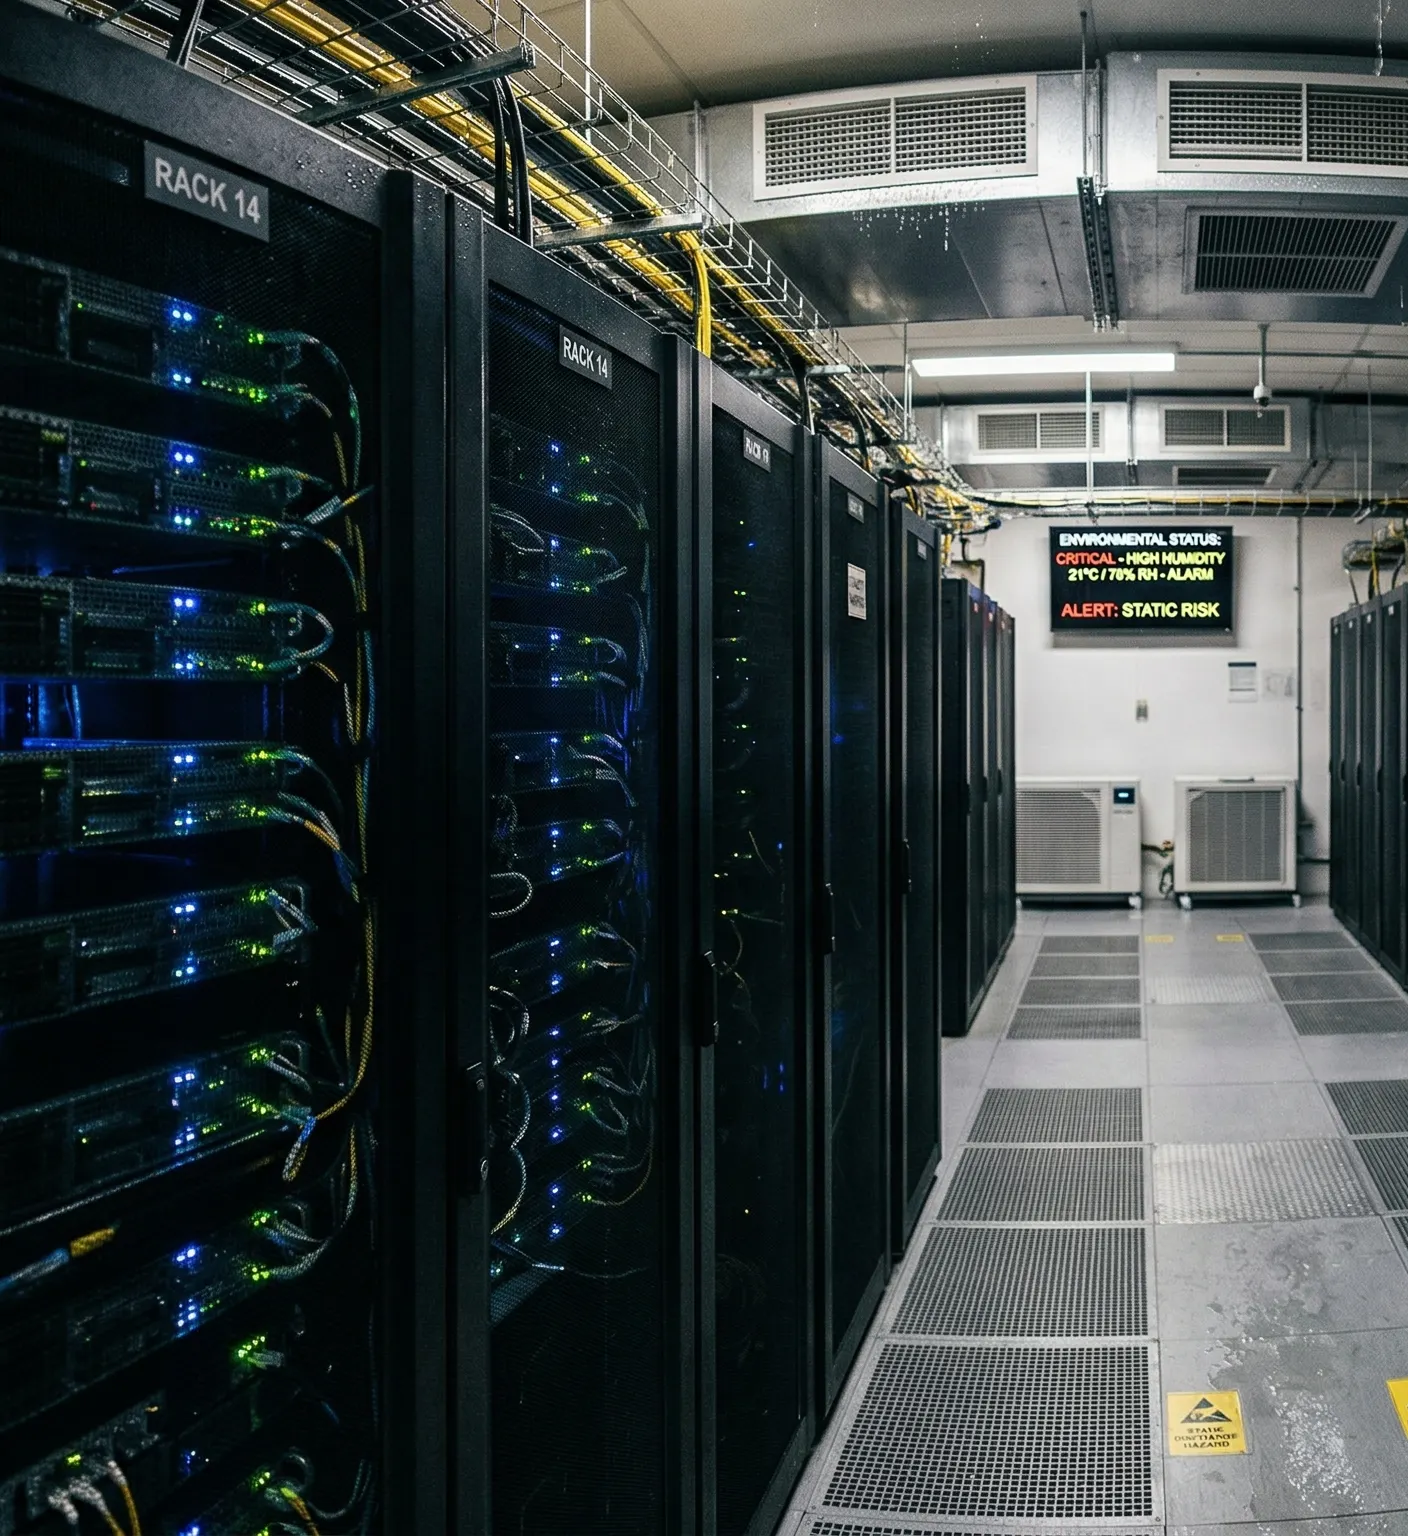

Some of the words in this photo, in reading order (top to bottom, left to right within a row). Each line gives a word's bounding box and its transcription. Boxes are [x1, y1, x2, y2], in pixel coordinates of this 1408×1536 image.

[155, 157, 227, 212] RACK
[235, 188, 260, 223] 14
[563, 336, 594, 372] RACK
[596, 354, 608, 378] 14
[1059, 532, 1168, 547] ENVIRONMENTAL
[1168, 532, 1222, 547] STATUS:
[1055, 552, 1117, 566] CRITICAL
[1126, 551, 1160, 566] HIGH
[1161, 551, 1227, 566] HUMIDITY
[1137, 567, 1159, 582] RH
[1166, 567, 1214, 582] ALARM
[1061, 602, 1119, 618] ALERT:
[1121, 602, 1179, 618] STATIC
[1180, 602, 1221, 618] RISK
